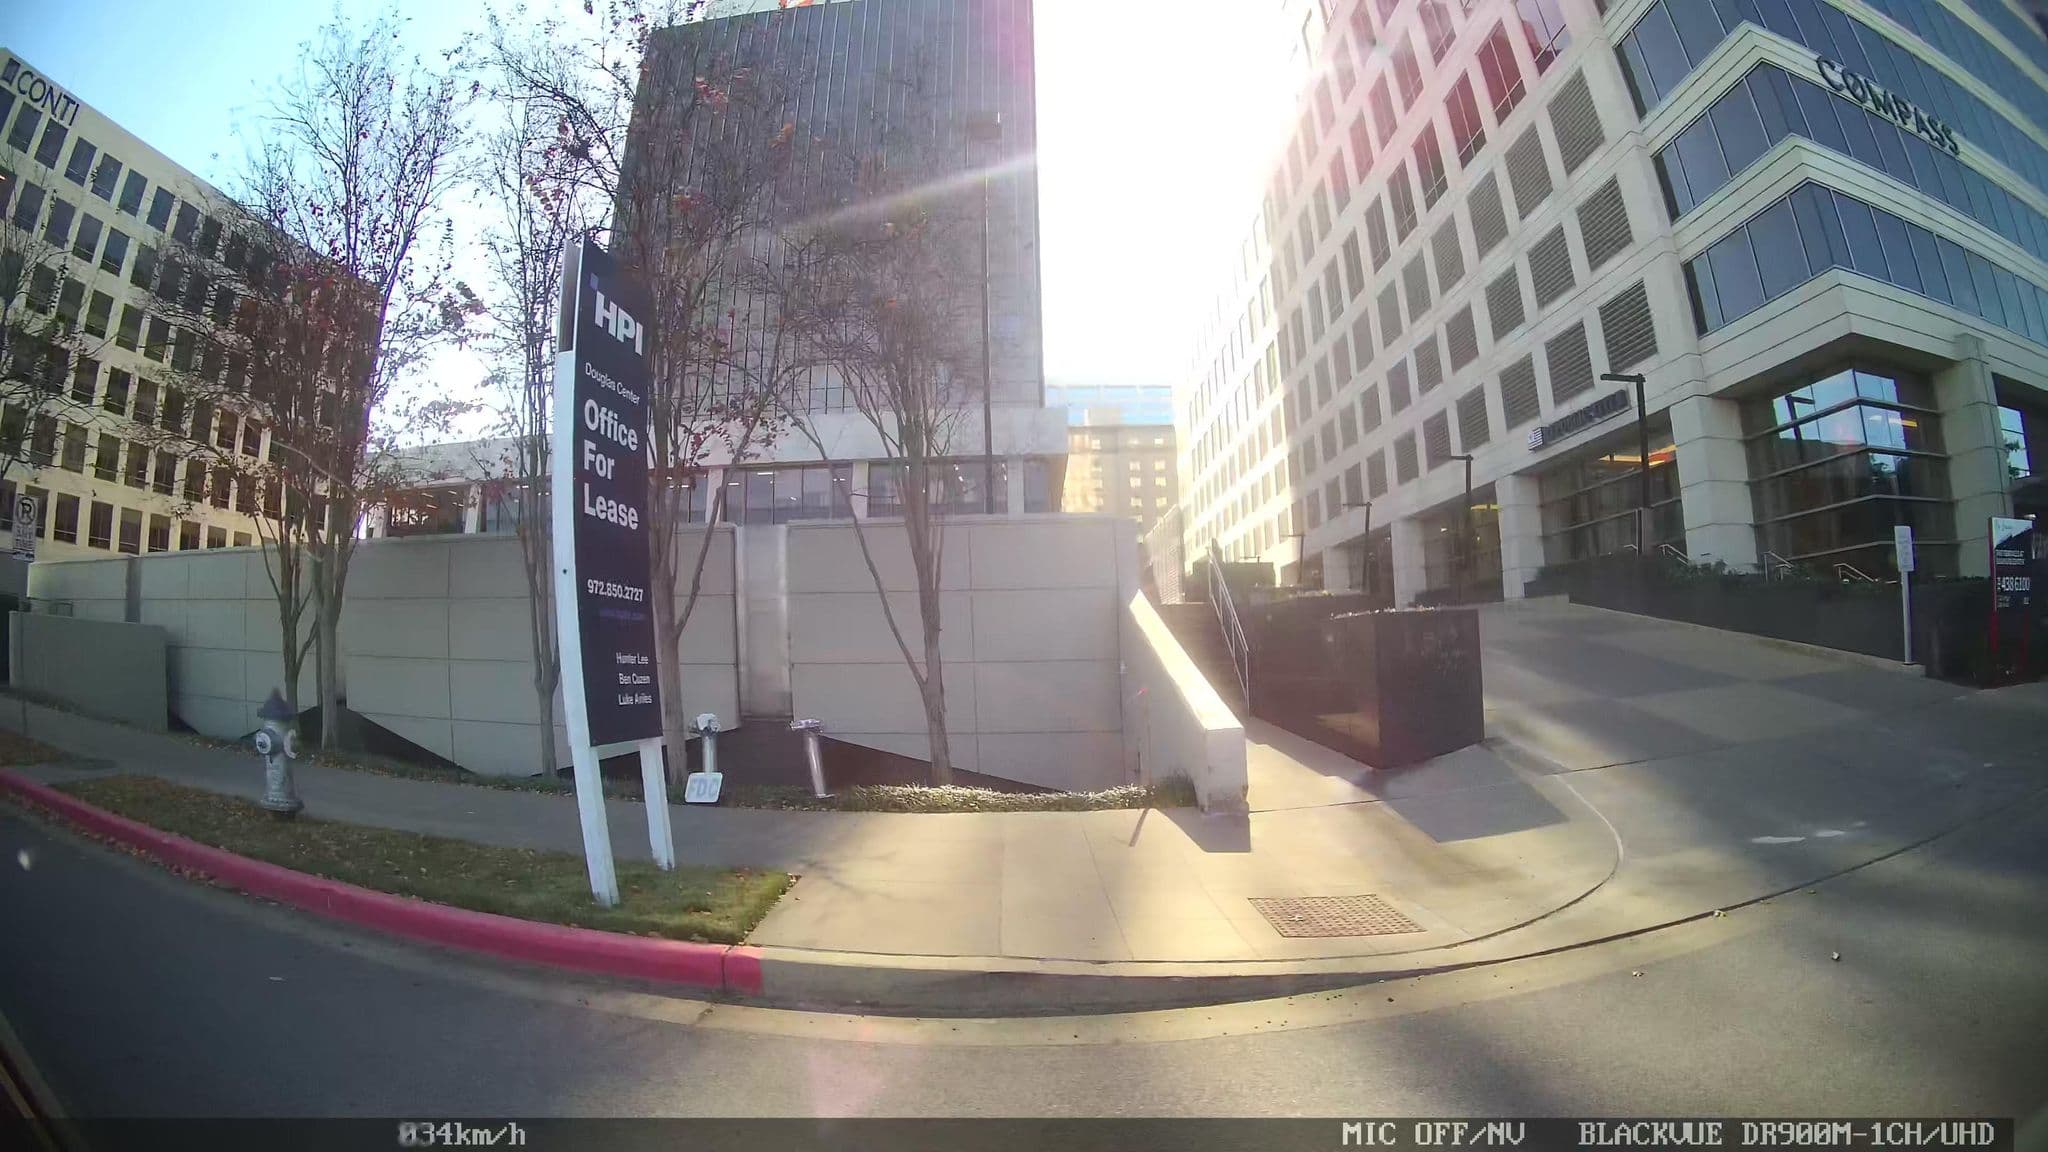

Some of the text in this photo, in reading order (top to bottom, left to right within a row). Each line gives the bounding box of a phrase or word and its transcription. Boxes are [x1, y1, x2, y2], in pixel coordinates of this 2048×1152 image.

[17, 70, 79, 126] CONTI
[1816, 55, 1961, 155] COMPASS
[594, 291, 644, 356] HPI
[585, 362, 640, 405] Douglas Center
[584, 399, 638, 451] Office
[584, 439, 615, 480] For
[584, 482, 639, 530] Lease
[587, 579, 643, 602] 972.850.2727
[619, 672, 631, 685] Ben
[637, 653, 649, 664] Lee
[618, 693, 634, 705] Luke
